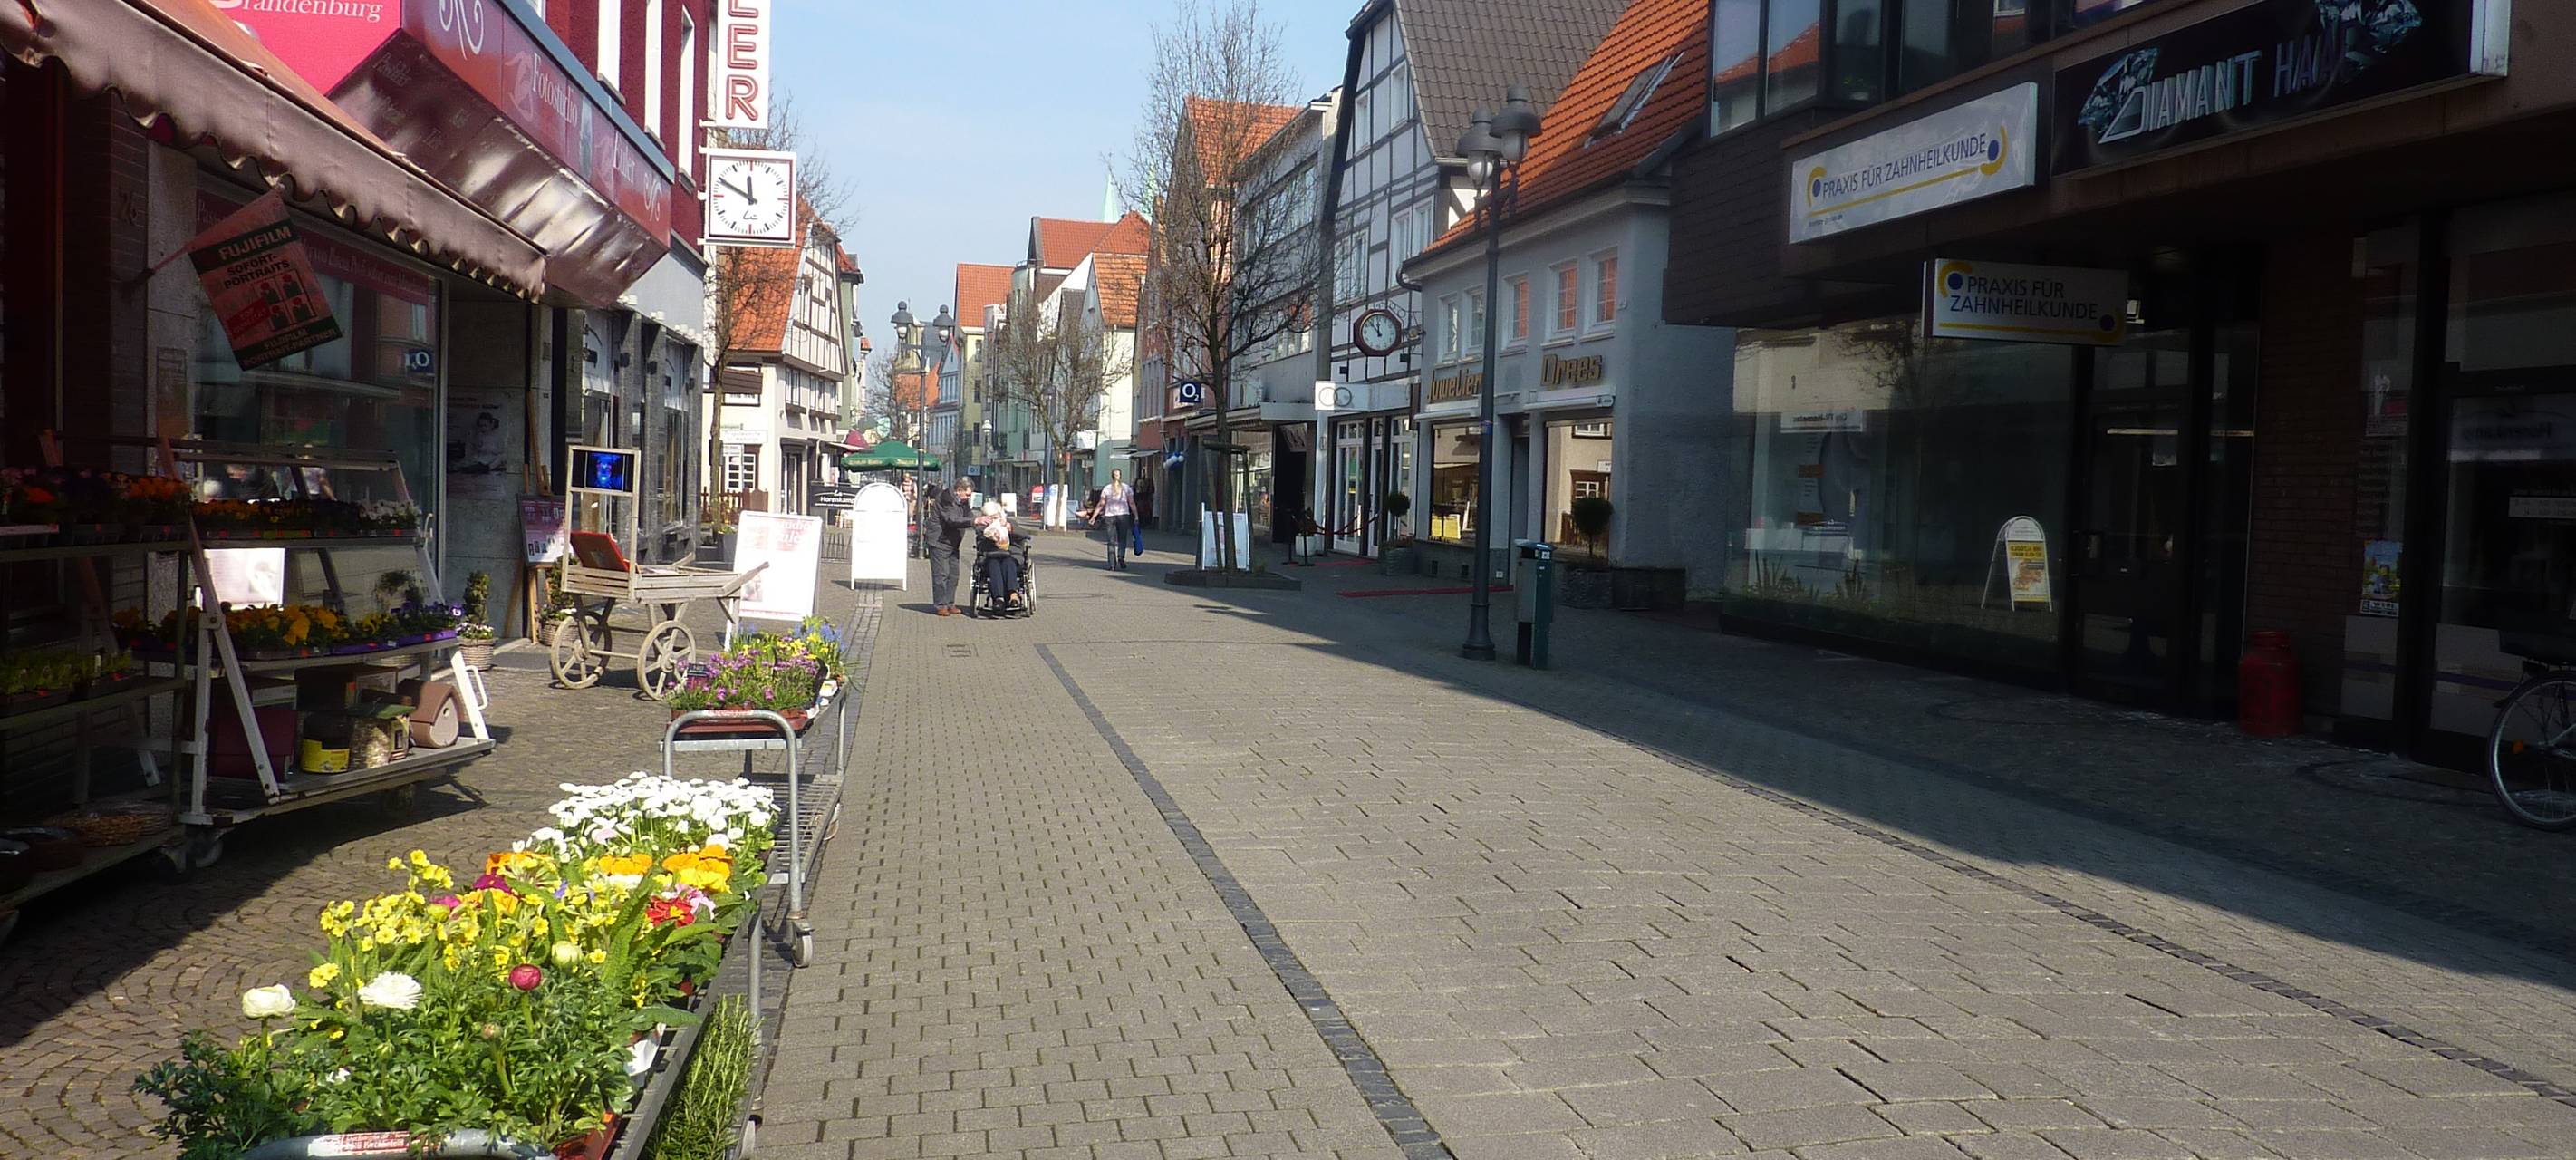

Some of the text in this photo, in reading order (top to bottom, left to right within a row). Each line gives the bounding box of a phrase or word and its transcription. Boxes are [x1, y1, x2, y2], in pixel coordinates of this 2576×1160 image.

[533, 52, 579, 128] Fotostudio
[2098, 49, 2262, 144] DIAMANT
[1823, 131, 1987, 199] PRAXIS FÜR ZAHNHEILKUNDE
[218, 226, 293, 261] FUJIFILM
[224, 259, 290, 289] PORTRAITS
[227, 253, 277, 276] SOFORT-
[1967, 276, 2065, 298] PRAXIS FÜR
[1950, 295, 2098, 320] ZAHNHEILKUNDE
[263, 327, 308, 350] FUJIFILM
[1426, 369, 1483, 404] Juwelier
[1541, 353, 1603, 387] Drees
